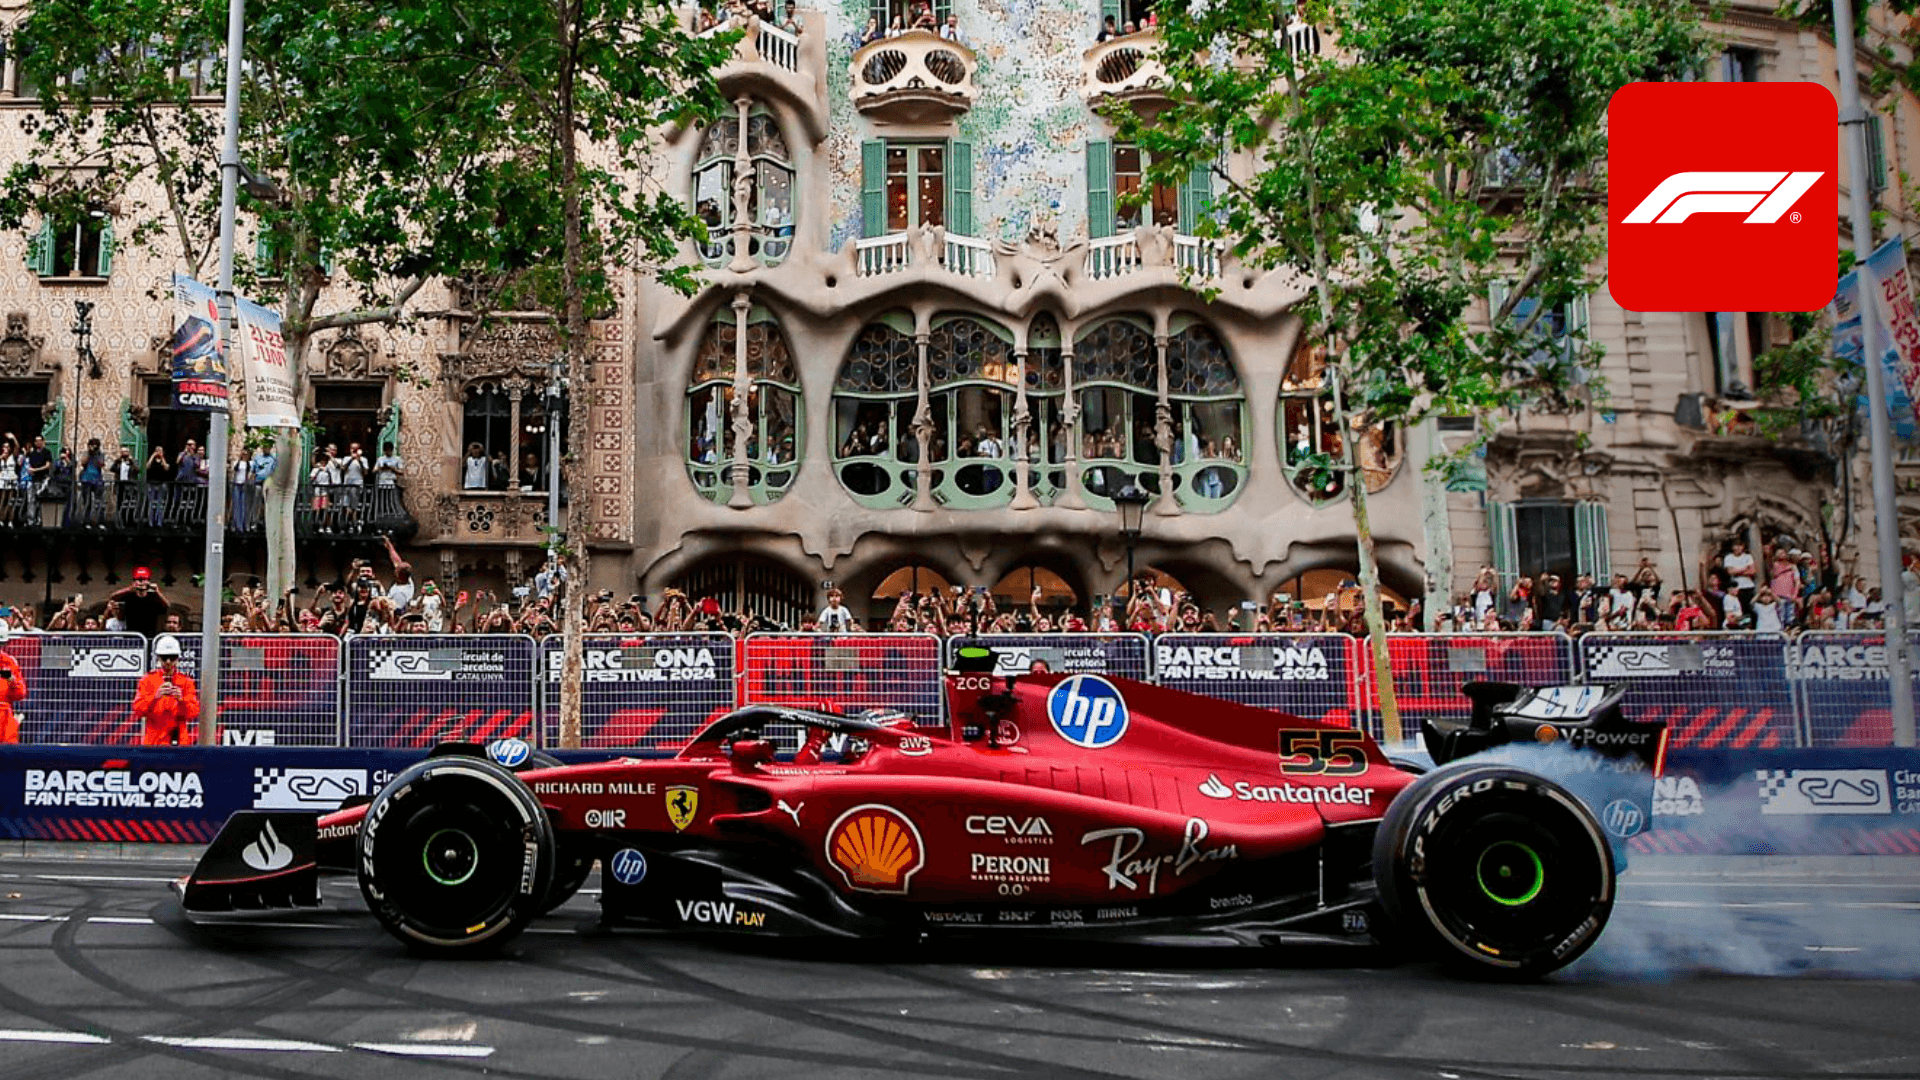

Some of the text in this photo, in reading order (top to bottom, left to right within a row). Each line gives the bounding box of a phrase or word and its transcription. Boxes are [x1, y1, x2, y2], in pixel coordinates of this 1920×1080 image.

[460, 652, 489, 662] ircuit
[549, 649, 715, 669] BRCONA
[1063, 647, 1090, 657] ircuit
[1158, 646, 1328, 667] BARCONA
[1783, 645, 1890, 667] BARCE
[460, 662, 504, 672] arcelona
[1064, 658, 1107, 667] arcelona
[455, 672, 504, 681] CATALUNYA
[587, 668, 667, 682] FESTIVAL
[669, 667, 716, 680] 2024
[956, 677, 991, 690] ZCG
[1281, 667, 1329, 680] 2024
[1060, 676, 1118, 747] hp
[899, 736, 931, 749] aws
[1560, 727, 1650, 745] V-Power
[1278, 728, 1368, 777] 55
[25, 769, 203, 794] BARCELONA
[534, 782, 656, 795] RICHARD MILLE
[24, 792, 204, 808] FAN FESTIVAL 2024
[1234, 781, 1375, 805] Santander
[1424, 777, 1495, 834] ZERO
[965, 815, 1053, 835] CEVA
[1611, 801, 1639, 837] hp
[363, 797, 390, 877] ZERO
[971, 853, 1051, 875] PERONI
[1081, 817, 1238, 894] Ray-Ban
[616, 849, 644, 884] hp
[676, 899, 766, 927] VGW PLAY
